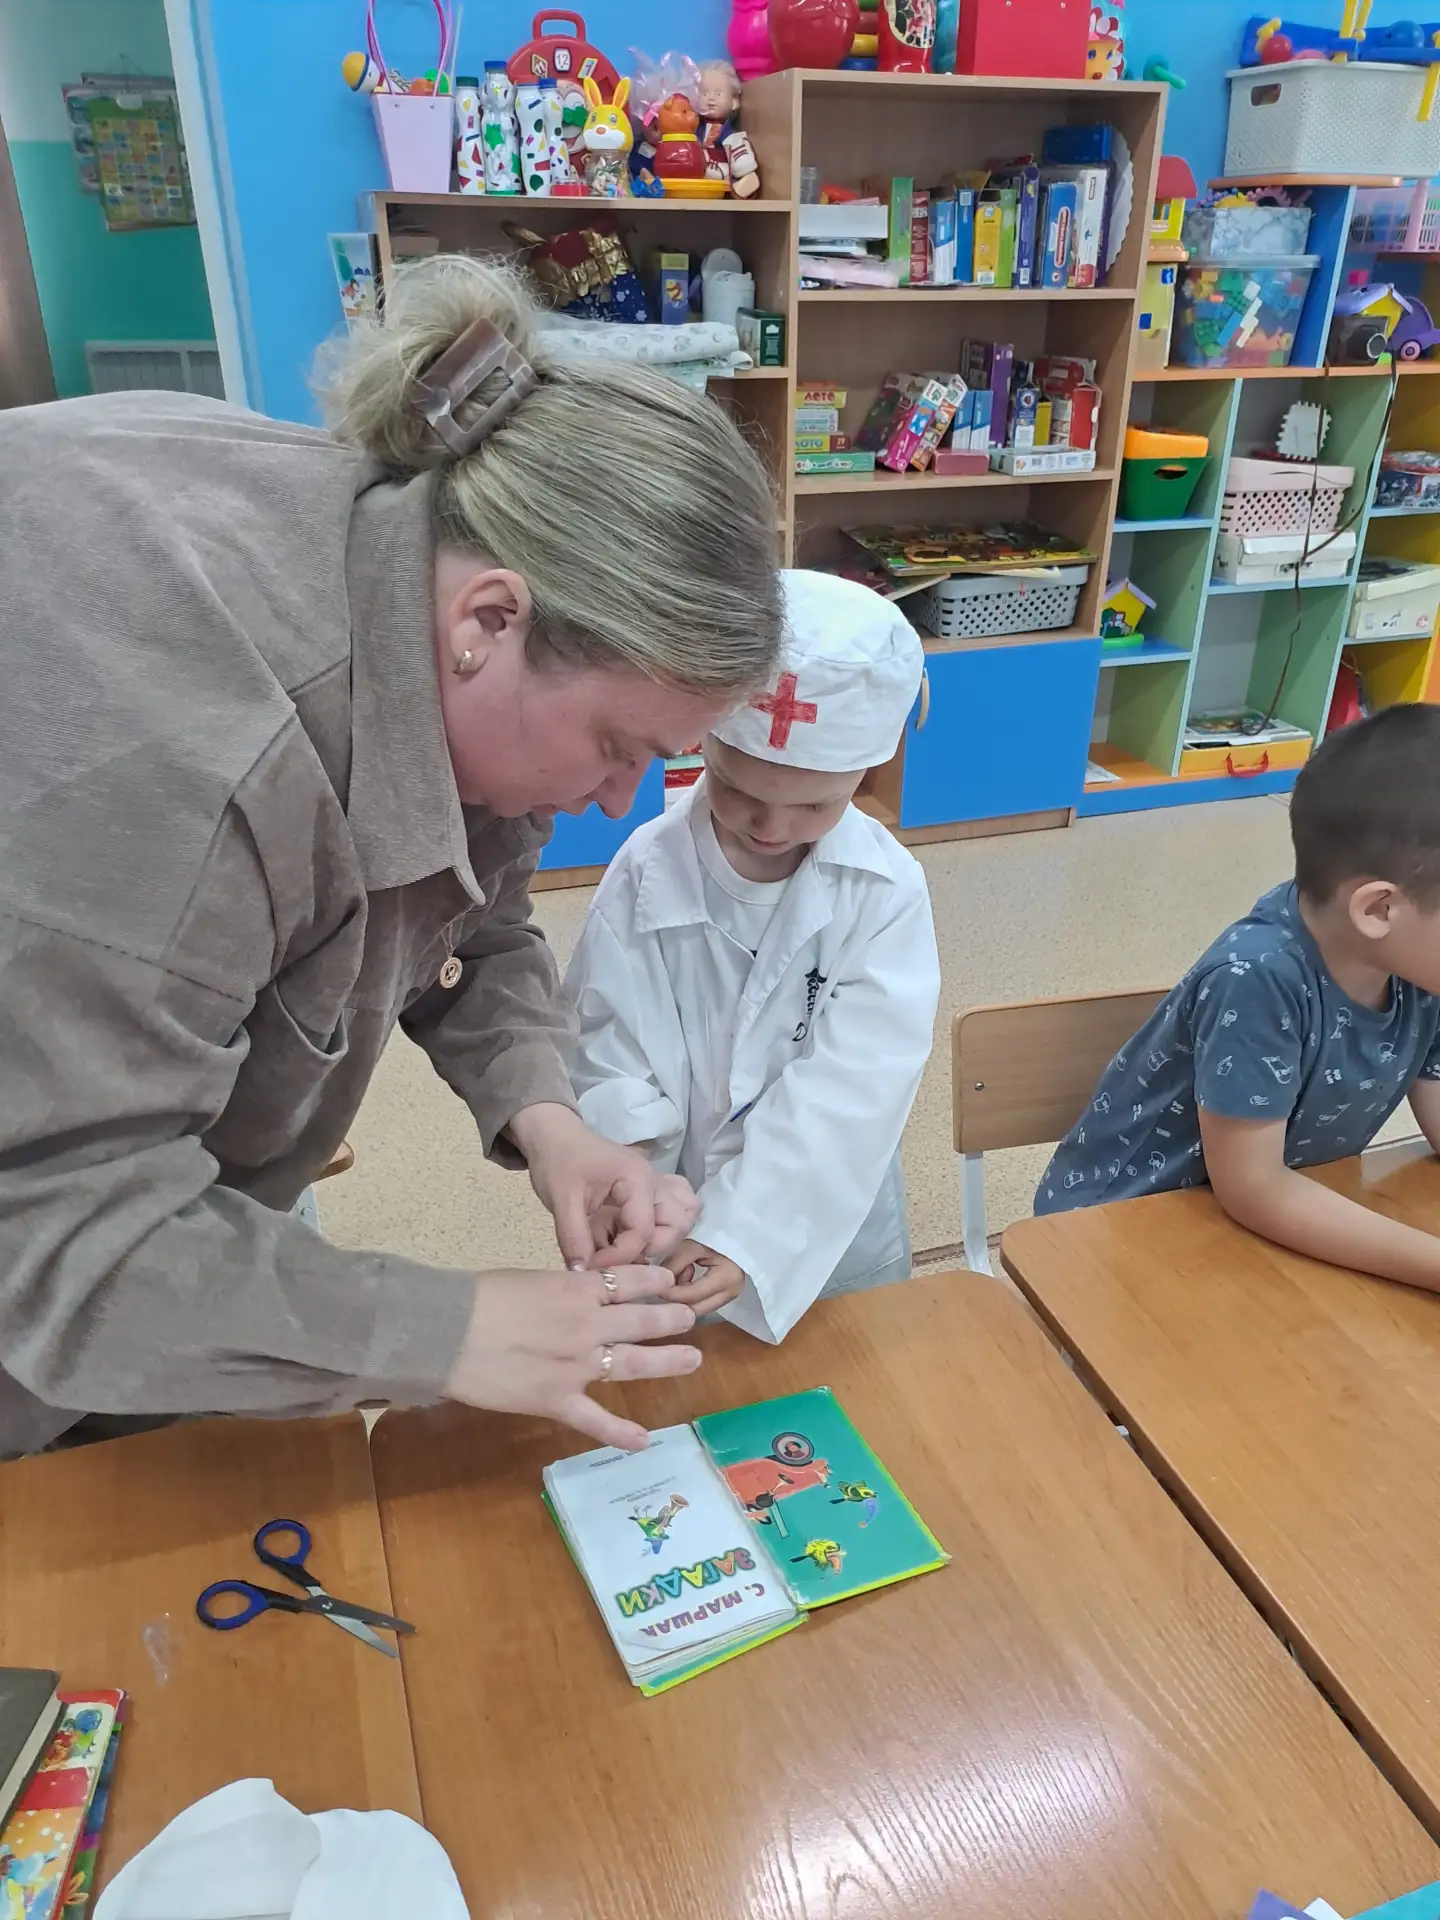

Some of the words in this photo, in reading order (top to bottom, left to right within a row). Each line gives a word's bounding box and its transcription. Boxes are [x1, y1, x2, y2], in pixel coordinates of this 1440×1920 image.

[556, 54, 568, 65] 12
[804, 391, 835, 401] ЛОТО
[615, 1546, 756, 1618] ЗАГАДКИ
[744, 1583, 765, 1597] С.
[639, 1590, 744, 1637] МАРШАК
